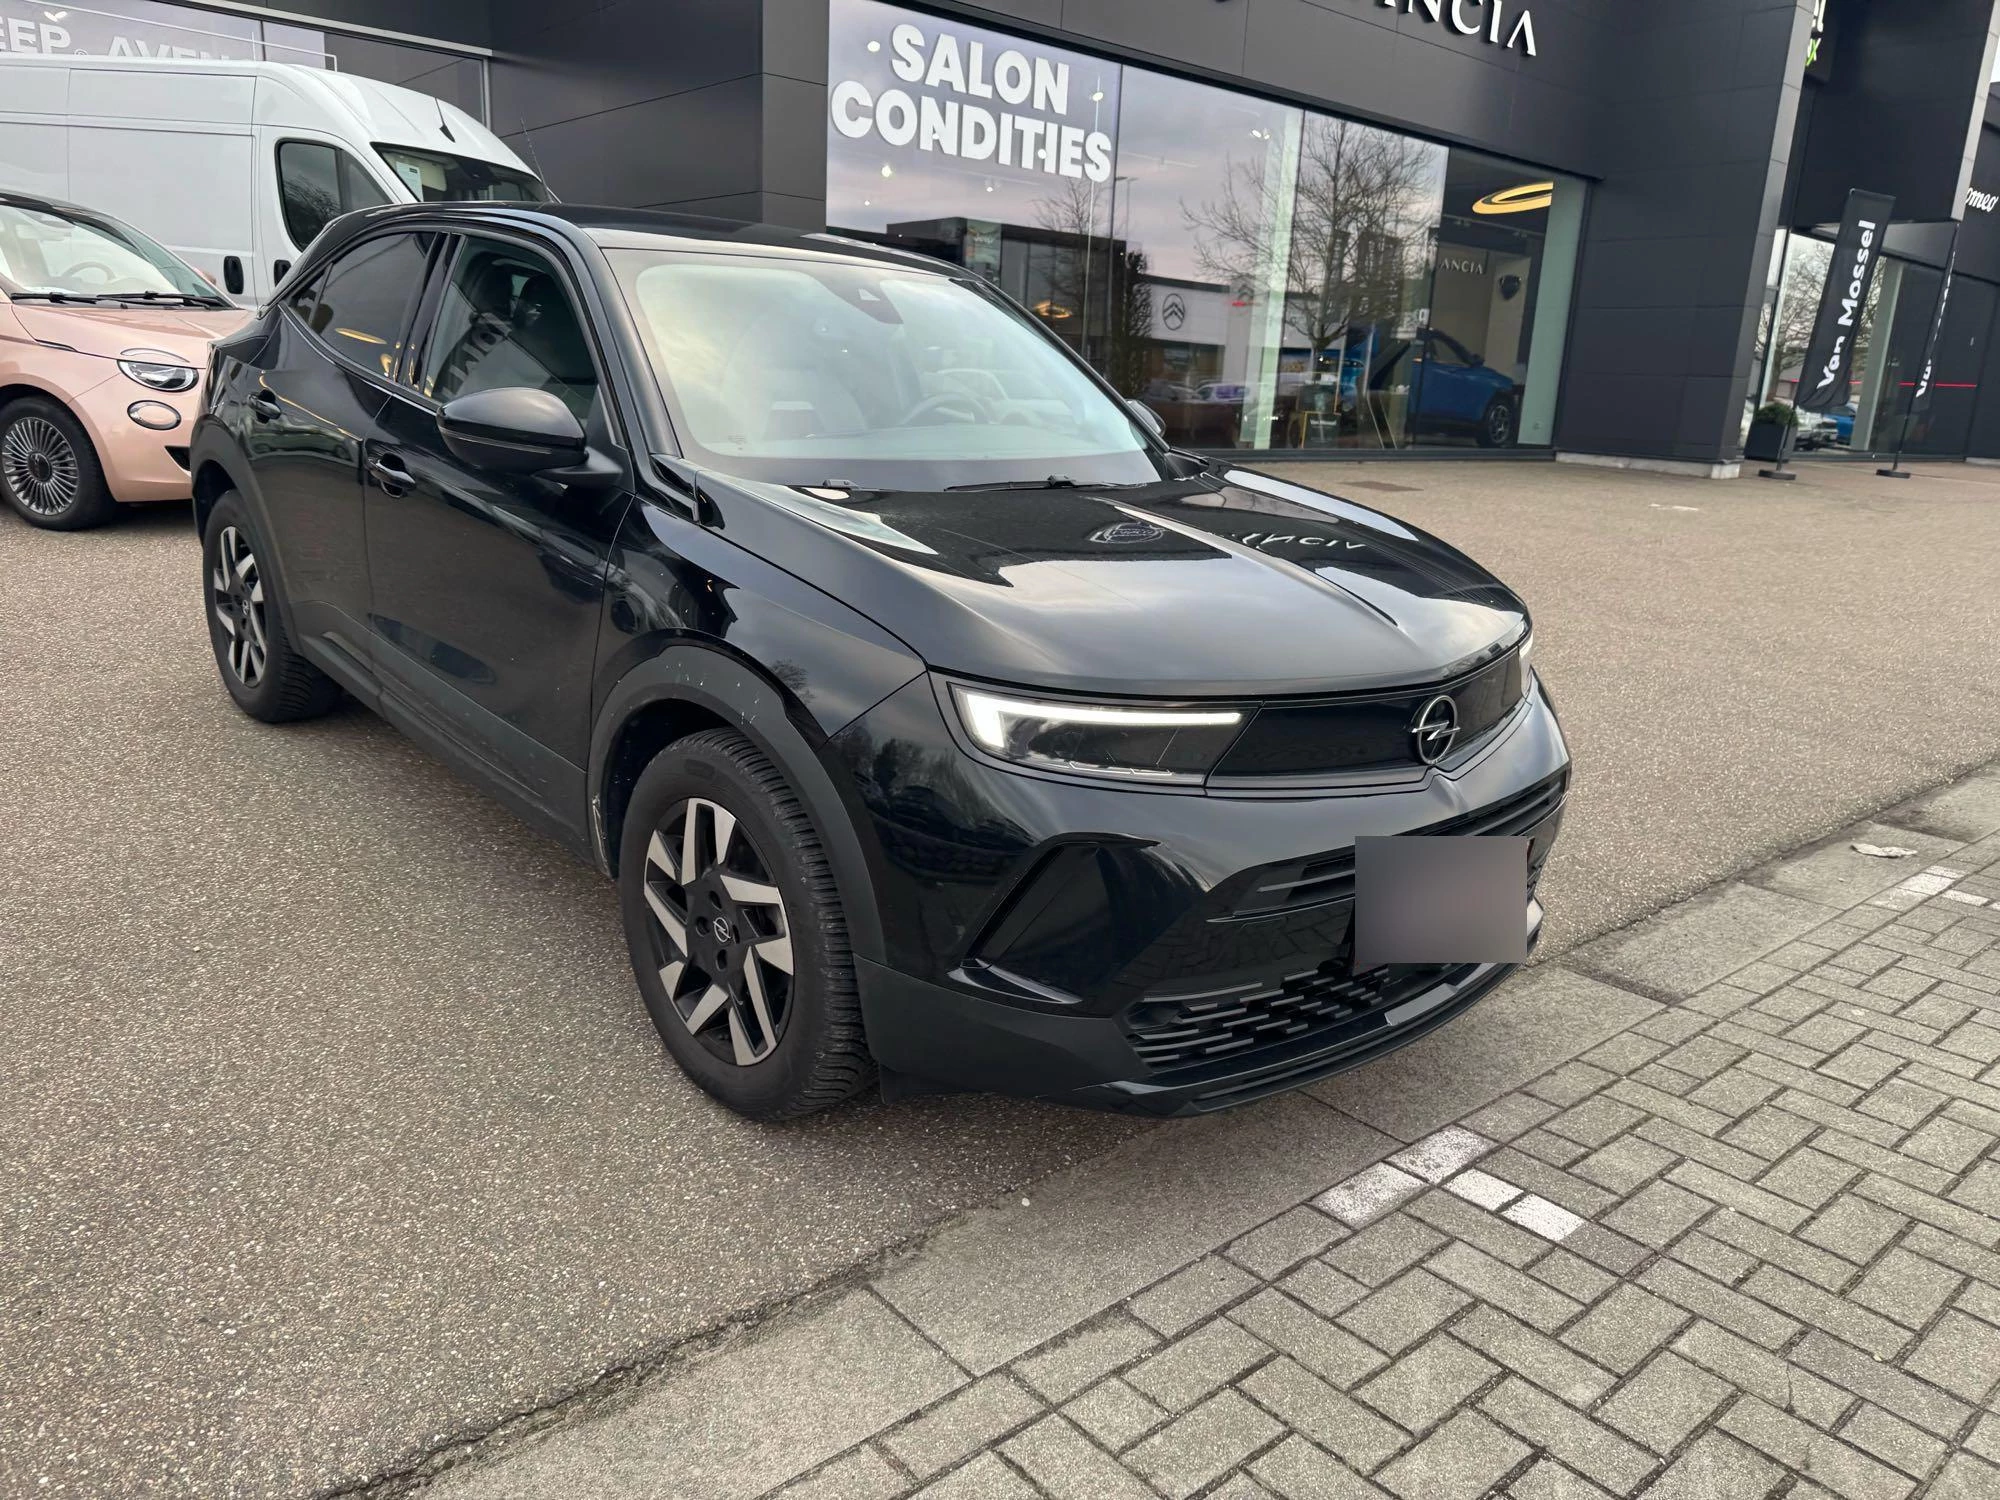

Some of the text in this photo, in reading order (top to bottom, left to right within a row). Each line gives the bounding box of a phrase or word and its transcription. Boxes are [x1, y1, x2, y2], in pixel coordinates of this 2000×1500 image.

[892, 24, 1070, 116] SALON
[831, 80, 1112, 182] CONDITIES
[1816, 219, 1876, 390] Van Mossel
